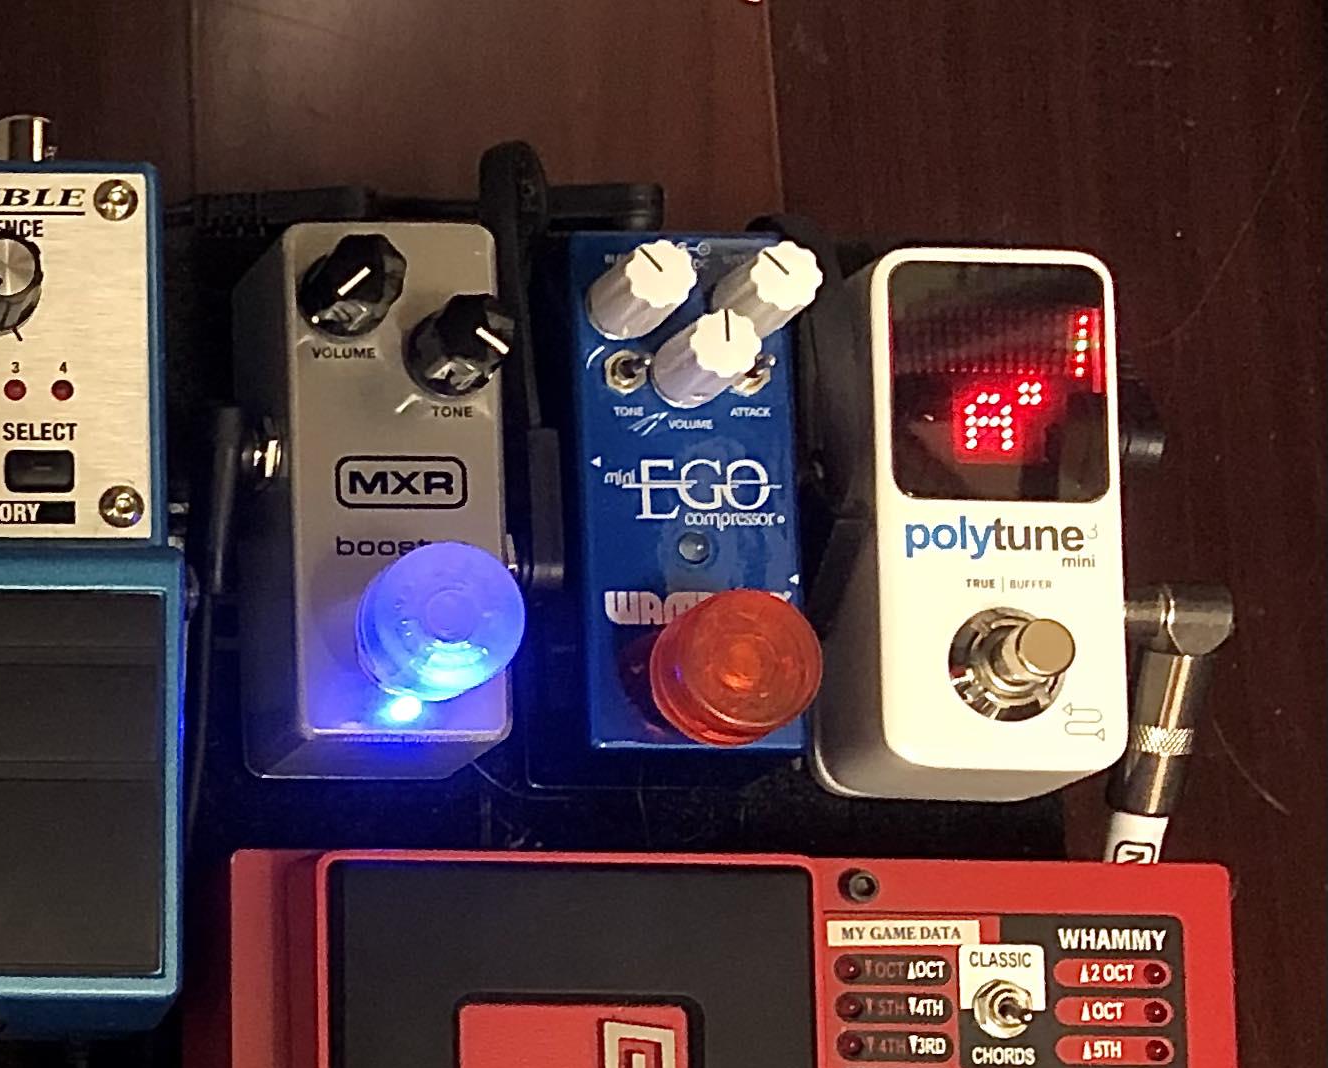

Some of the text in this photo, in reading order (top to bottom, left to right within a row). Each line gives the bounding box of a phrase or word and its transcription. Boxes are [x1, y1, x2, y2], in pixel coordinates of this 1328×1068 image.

[311, 348, 376, 359] VOLUME
[433, 406, 473, 418] TONE
[614, 406, 644, 417] TONE
[730, 407, 771, 418] ATTACK
[2, 423, 77, 441] SELECT
[668, 419, 713, 430] VOLUME
[349, 471, 454, 495] MXR
[604, 459, 782, 519] mini EGO
[905, 516, 1084, 560] polytune
[1061, 556, 1095, 568] mini
[966, 579, 1052, 589] TRUE BUFFER
[841, 927, 961, 940] MY GAME DATA
[1058, 928, 1167, 951] WHAMMY
[969, 952, 1031, 968] CLASSIC
[916, 961, 945, 978] OCT
[1091, 964, 1134, 982] 2 OCT
[1092, 1003, 1124, 1020] OCT
[918, 1036, 946, 1055] 3RD
[1092, 1041, 1122, 1058] 5TH
[972, 1047, 1036, 1065] CHORDS
